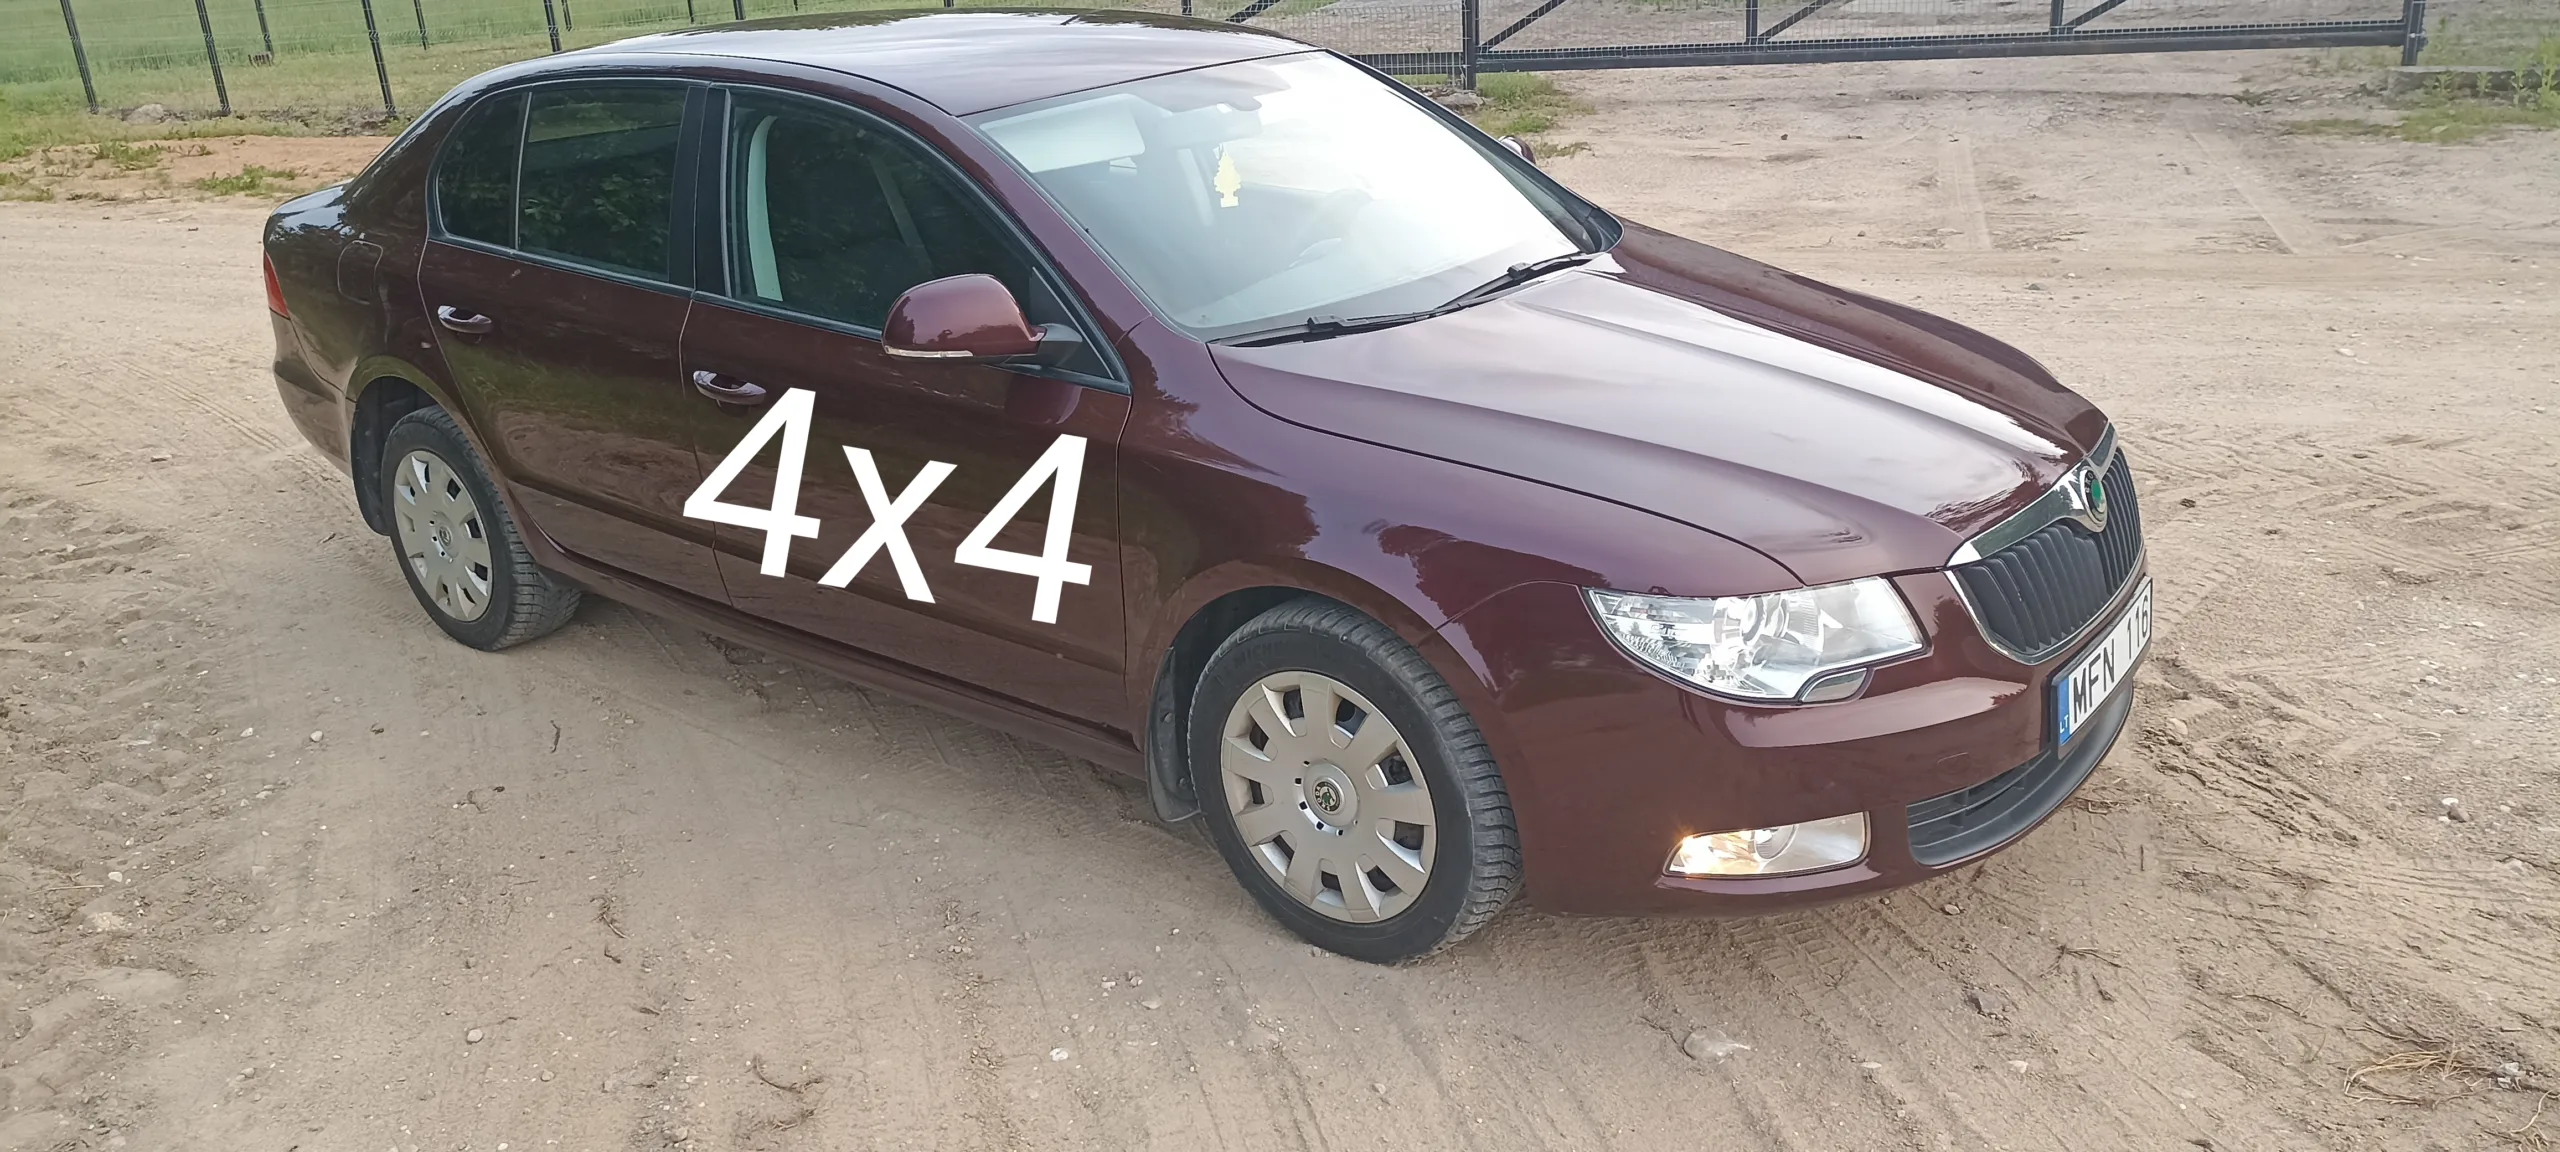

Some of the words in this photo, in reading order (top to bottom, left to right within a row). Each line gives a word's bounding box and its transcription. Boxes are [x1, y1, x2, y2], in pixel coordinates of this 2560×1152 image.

[2073, 639, 2115, 724] MFN
[2127, 595, 2149, 660] 116
[2059, 714, 2069, 734] LT
